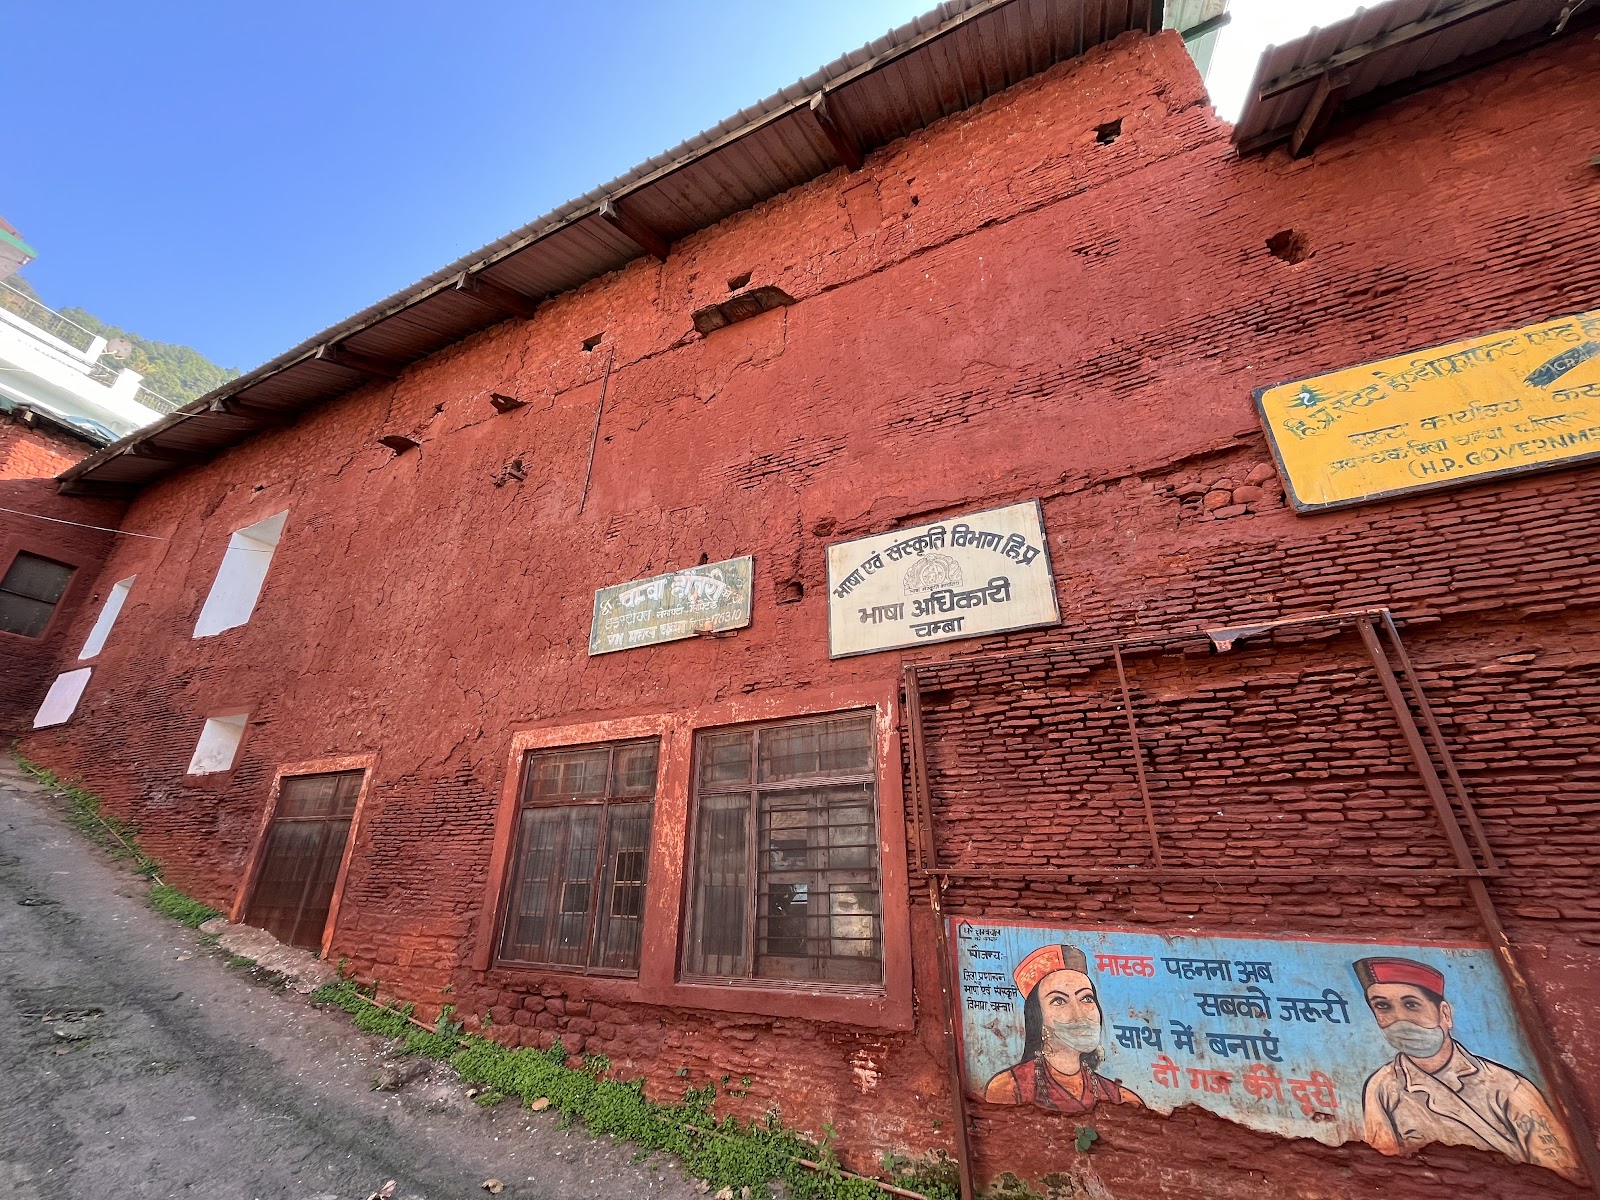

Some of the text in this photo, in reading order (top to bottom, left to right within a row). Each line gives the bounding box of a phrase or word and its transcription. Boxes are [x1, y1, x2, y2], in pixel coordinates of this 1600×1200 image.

[833, 568, 866, 599] भाषा
[860, 550, 886, 575] एवं
[883, 525, 948, 562] संस्कृति
[950, 523, 1004, 553] विभाग
[858, 575, 1012, 625] भाषा अधिकारी
[909, 616, 965, 638] चम्बा
[1094, 953, 1275, 984] मास्क पहनना अब
[1193, 986, 1351, 1024] सबको जरूरी
[1113, 1019, 1284, 1063] साथ में बनाएं
[1151, 1054, 1340, 1117] दो गज की दूरी
